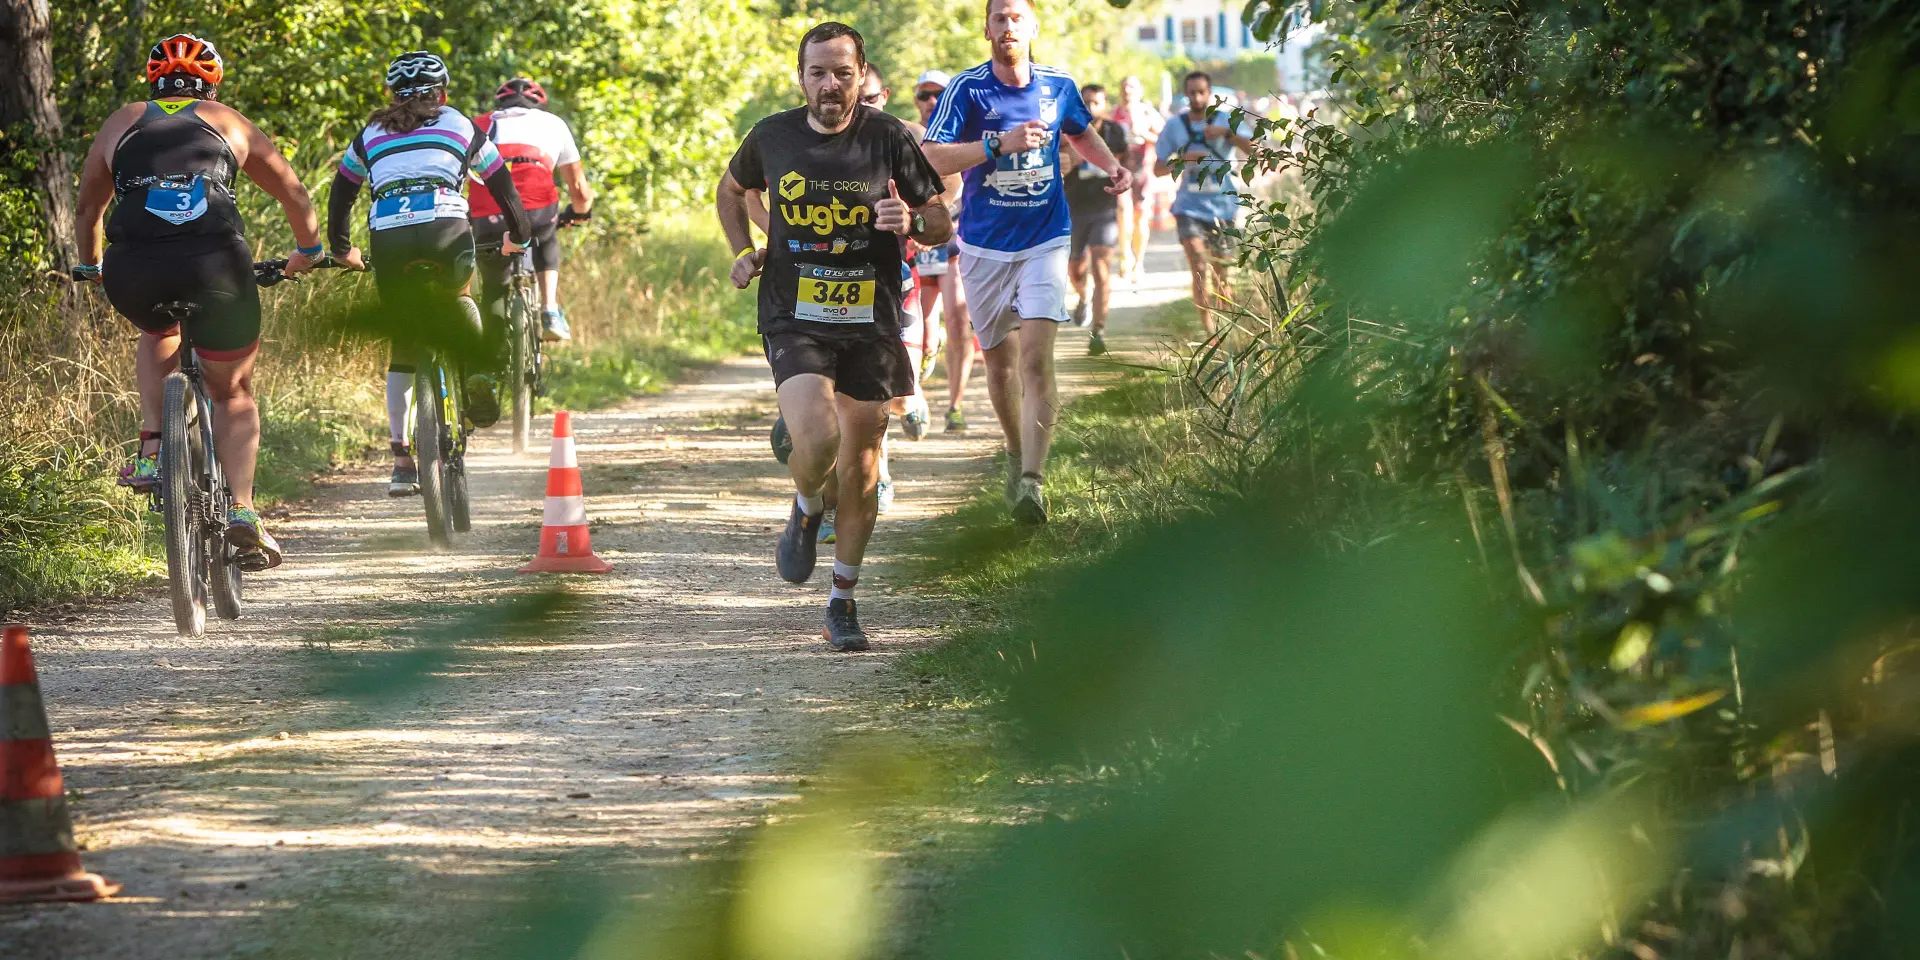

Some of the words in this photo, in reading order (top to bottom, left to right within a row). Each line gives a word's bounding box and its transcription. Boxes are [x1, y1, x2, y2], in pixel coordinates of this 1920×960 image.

[809, 180, 830, 191] THE
[176, 192, 192, 210] 3
[398, 196, 411, 213] 2
[780, 196, 870, 236] wgtn
[812, 281, 861, 305] 348
